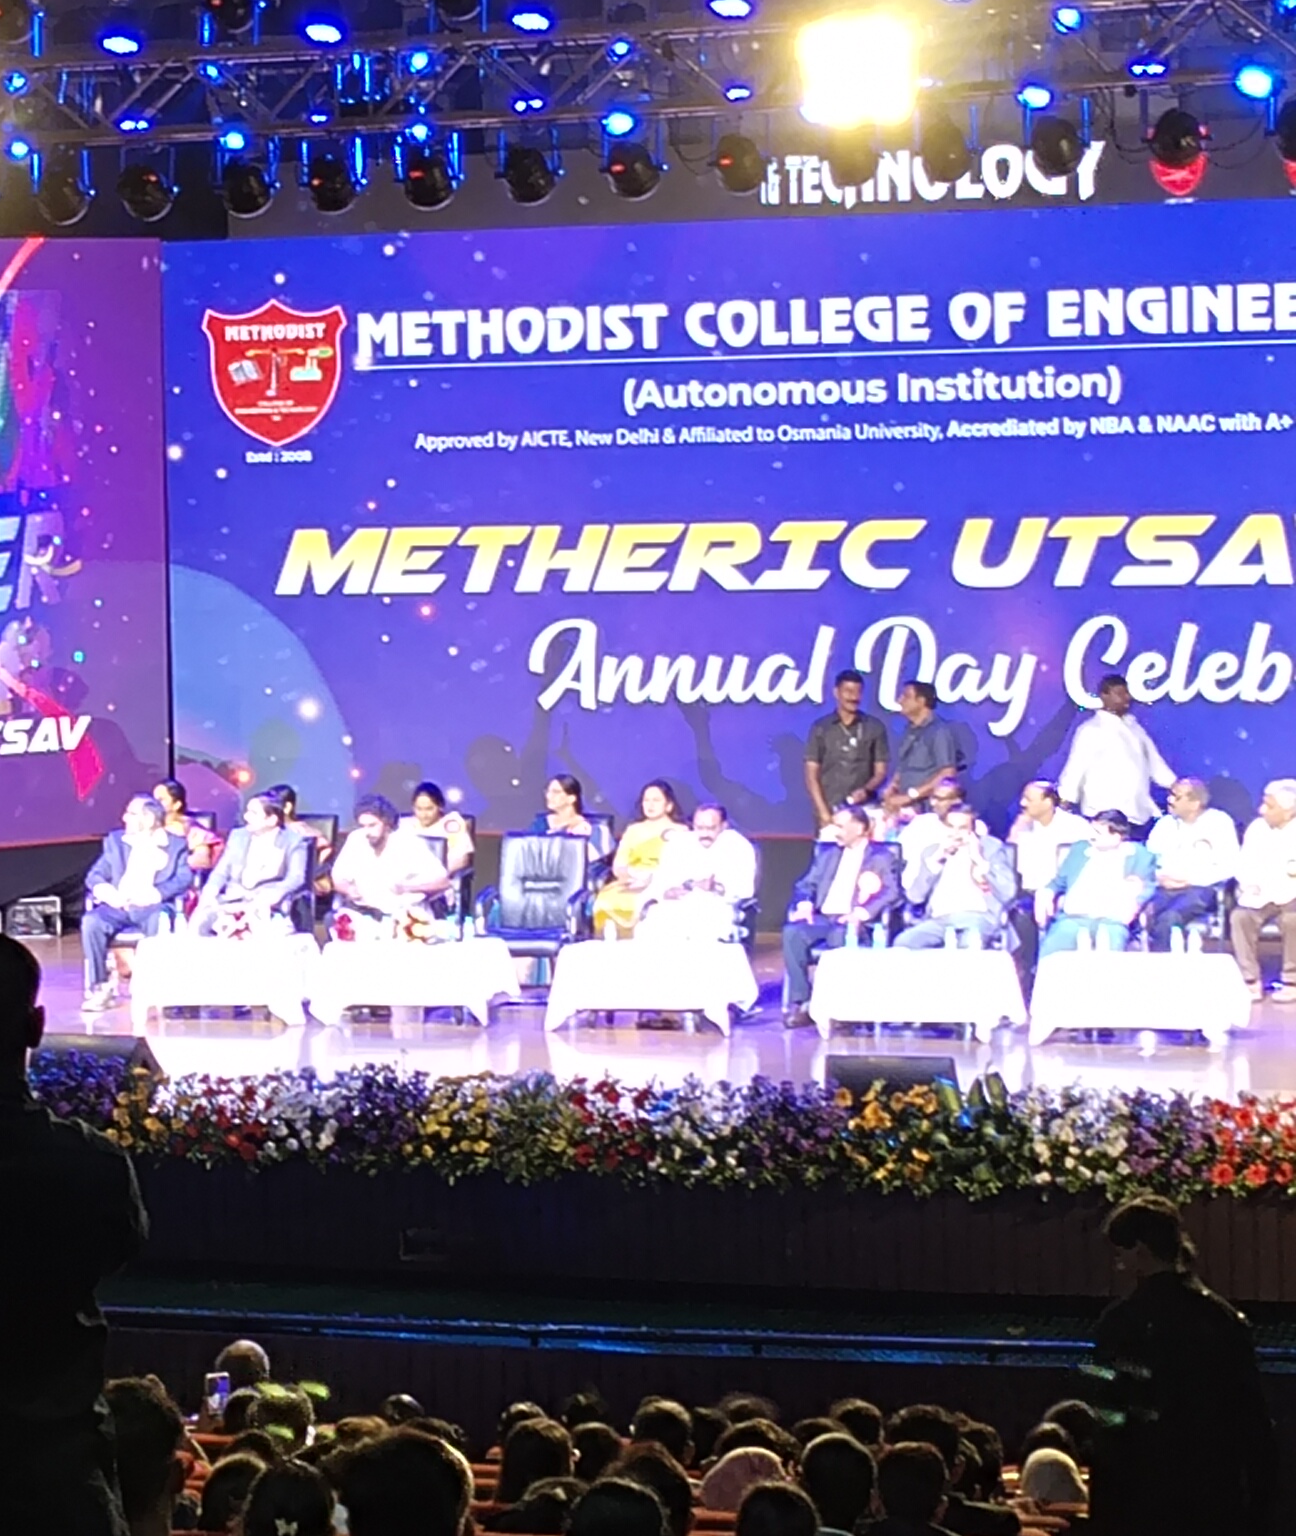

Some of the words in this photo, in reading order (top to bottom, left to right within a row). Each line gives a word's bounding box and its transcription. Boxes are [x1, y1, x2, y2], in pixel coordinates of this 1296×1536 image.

[224, 322, 326, 342] METHODIST
[357, 303, 668, 360] METHODIST
[684, 295, 931, 348] COLLEGE
[948, 291, 1026, 345] OF
[623, 375, 887, 416] (Autonomous
[897, 365, 1123, 405] Institution)
[415, 431, 494, 452] Approved
[497, 430, 518, 451] by
[575, 429, 613, 446] New
[616, 427, 660, 445] Delhi
[662, 427, 676, 444] &
[679, 425, 753, 443] Affiliated
[756, 427, 775, 442] to
[777, 423, 852, 442] Osmania
[854, 421, 944, 443] University,
[1063, 416, 1087, 439] by
[1090, 415, 1135, 434] NBA
[1138, 415, 1153, 433] &
[1156, 413, 1216, 433] NAAC
[1218, 412, 1263, 432] with
[1265, 412, 1294, 431] A+
[274, 519, 928, 595] METHERIC
[951, 514, 1296, 588] UTSA
[528, 618, 836, 711] Annual
[854, 615, 1037, 736] Day
